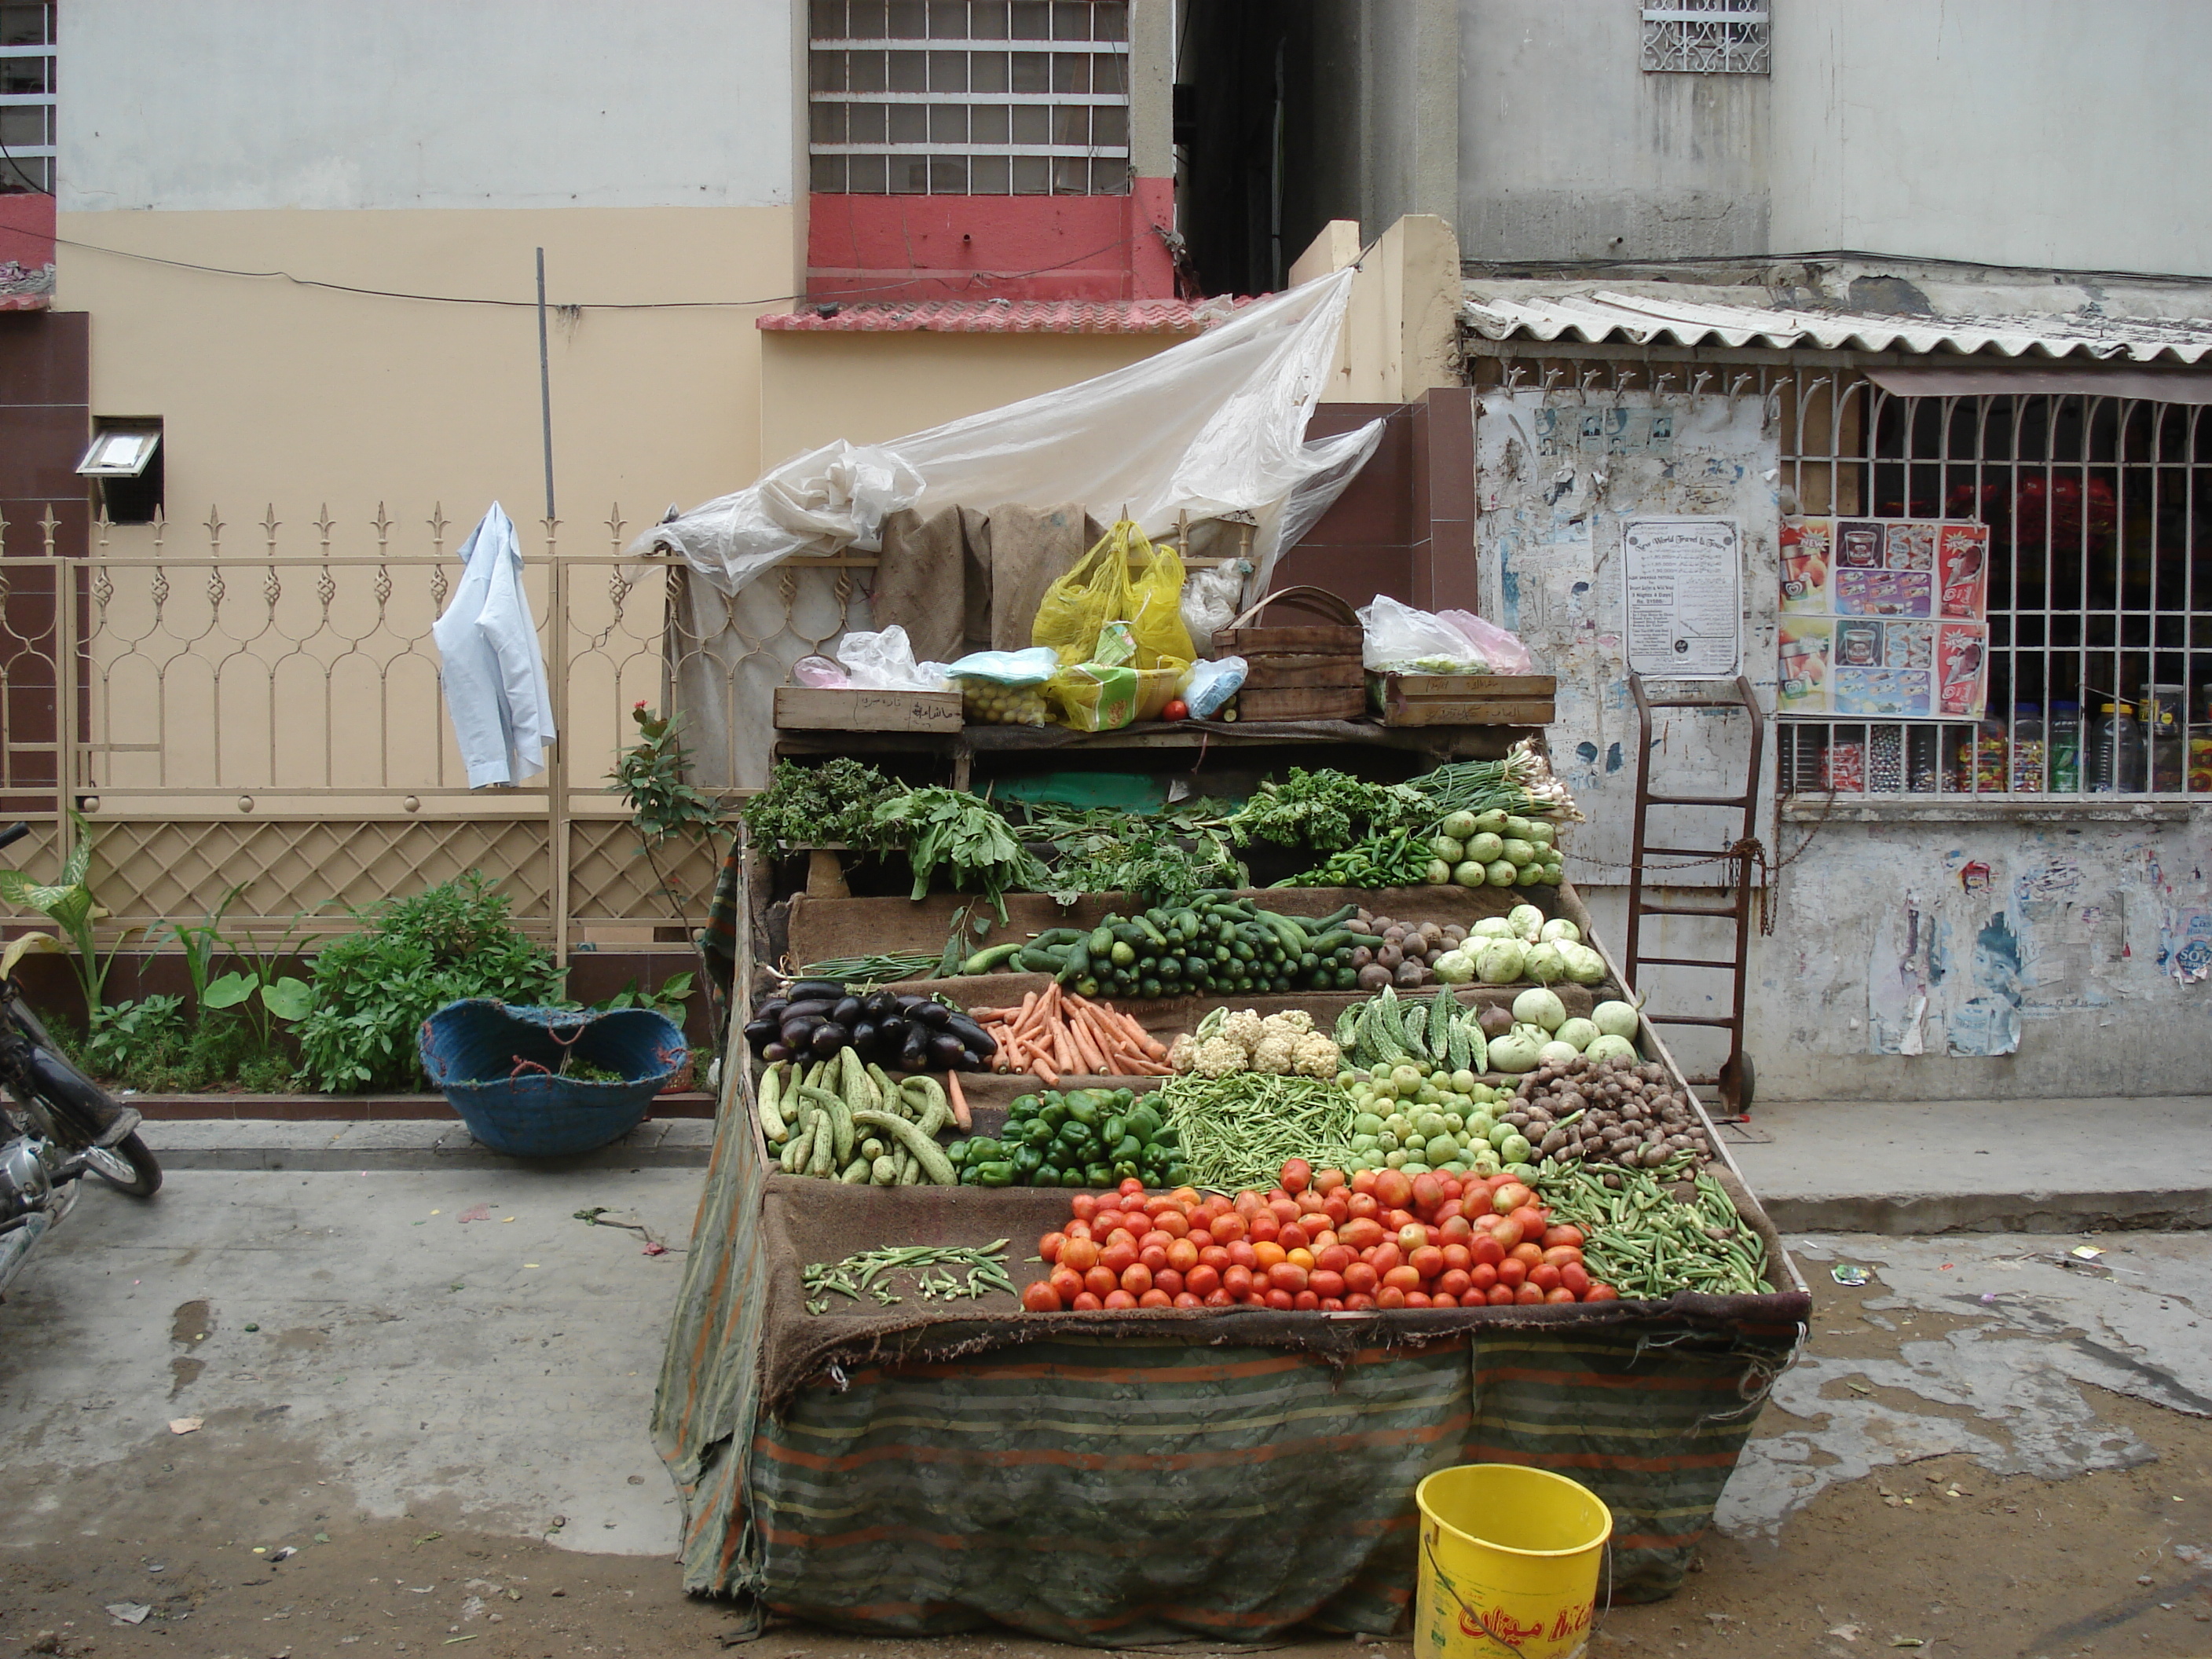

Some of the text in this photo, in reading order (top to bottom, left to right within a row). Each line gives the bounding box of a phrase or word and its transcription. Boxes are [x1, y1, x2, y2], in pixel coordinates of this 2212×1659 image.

[1635, 542, 1651, 551] New
[1653, 535, 1674, 544] World
[1675, 535, 1698, 544] Travel
[1699, 537, 1705, 545] &
[1706, 539, 1727, 551] Tours
[1800, 538, 1826, 548] NEW
